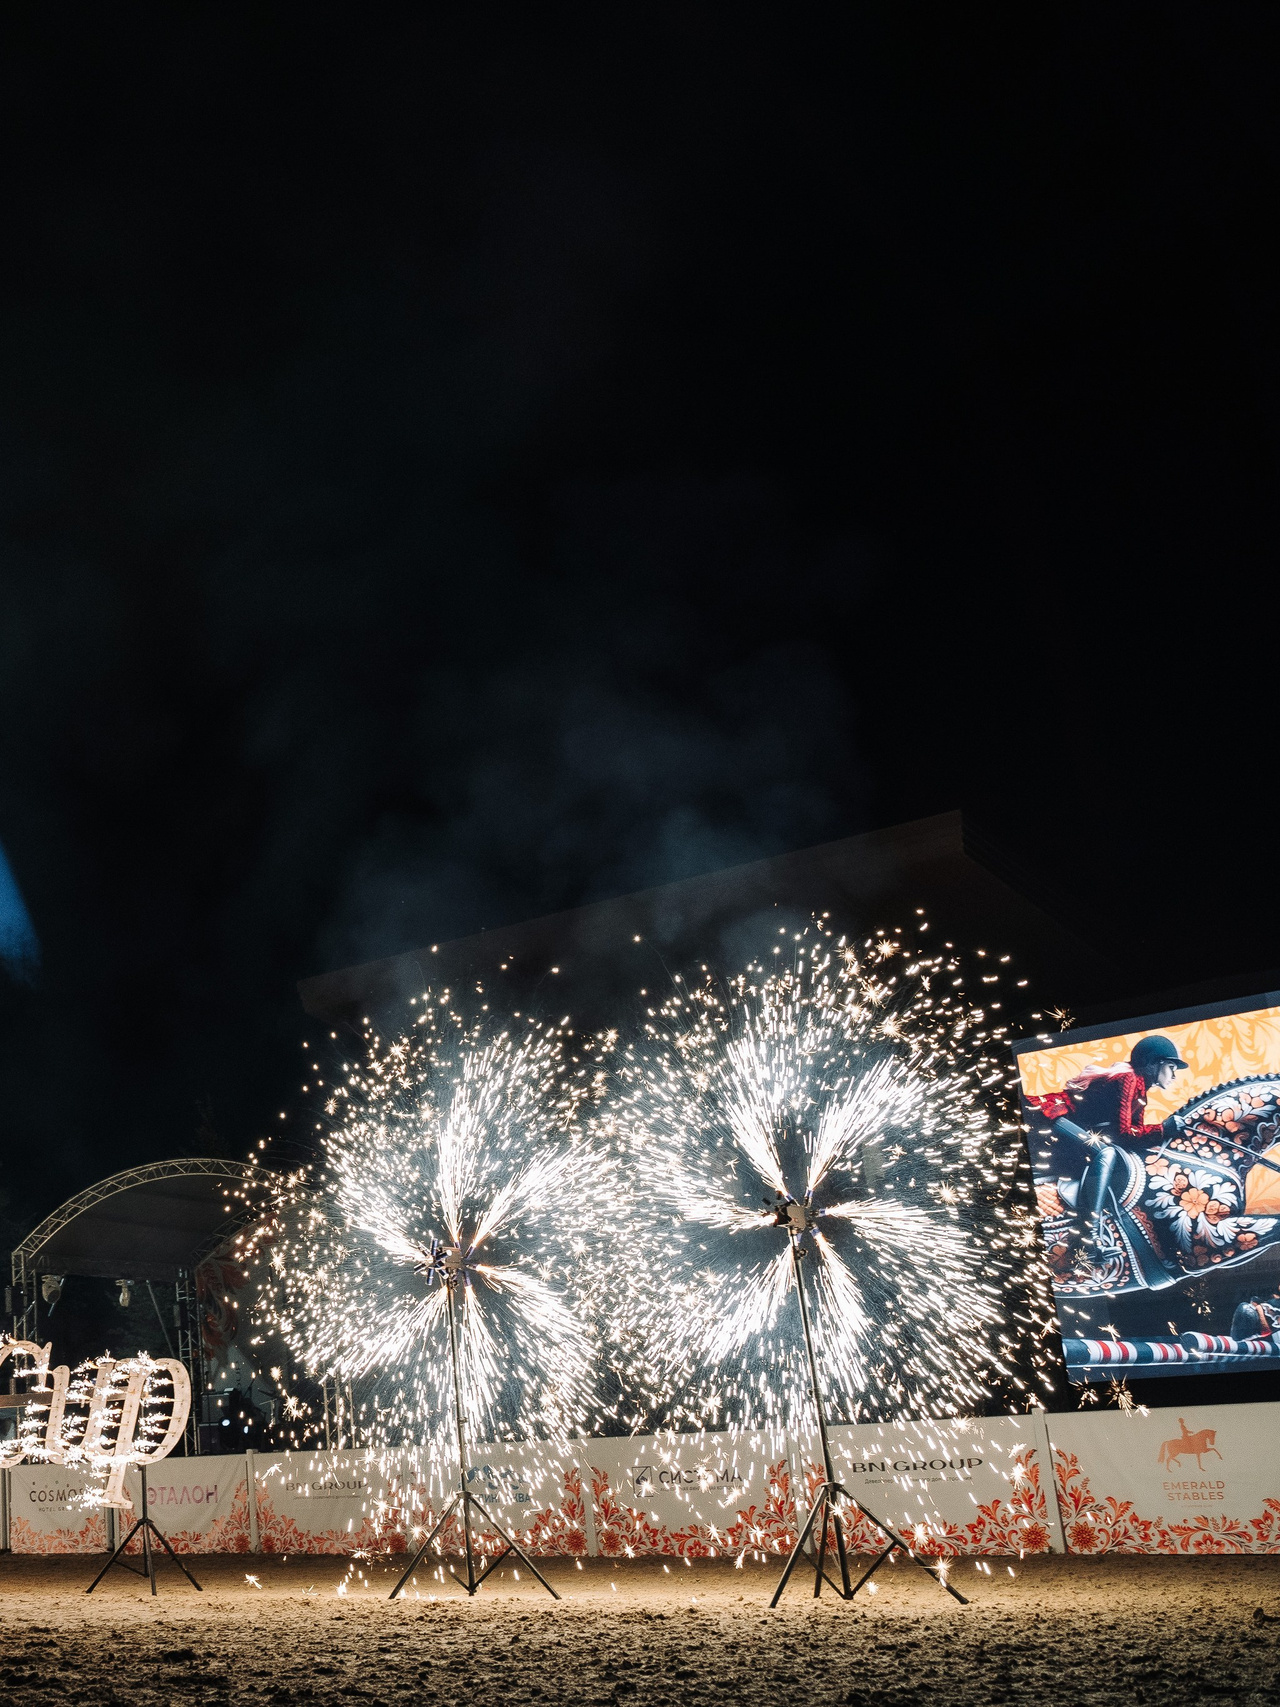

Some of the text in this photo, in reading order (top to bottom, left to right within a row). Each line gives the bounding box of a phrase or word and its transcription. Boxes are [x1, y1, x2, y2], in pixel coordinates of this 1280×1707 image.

[852, 1457, 983, 1473] BN GROUP
[286, 1479, 368, 1492] BN GROUP
[1162, 1480, 1225, 1490] EMERALD
[147, 1484, 218, 1505] ЭТАЛОН
[1167, 1491, 1225, 1501] STABLES
